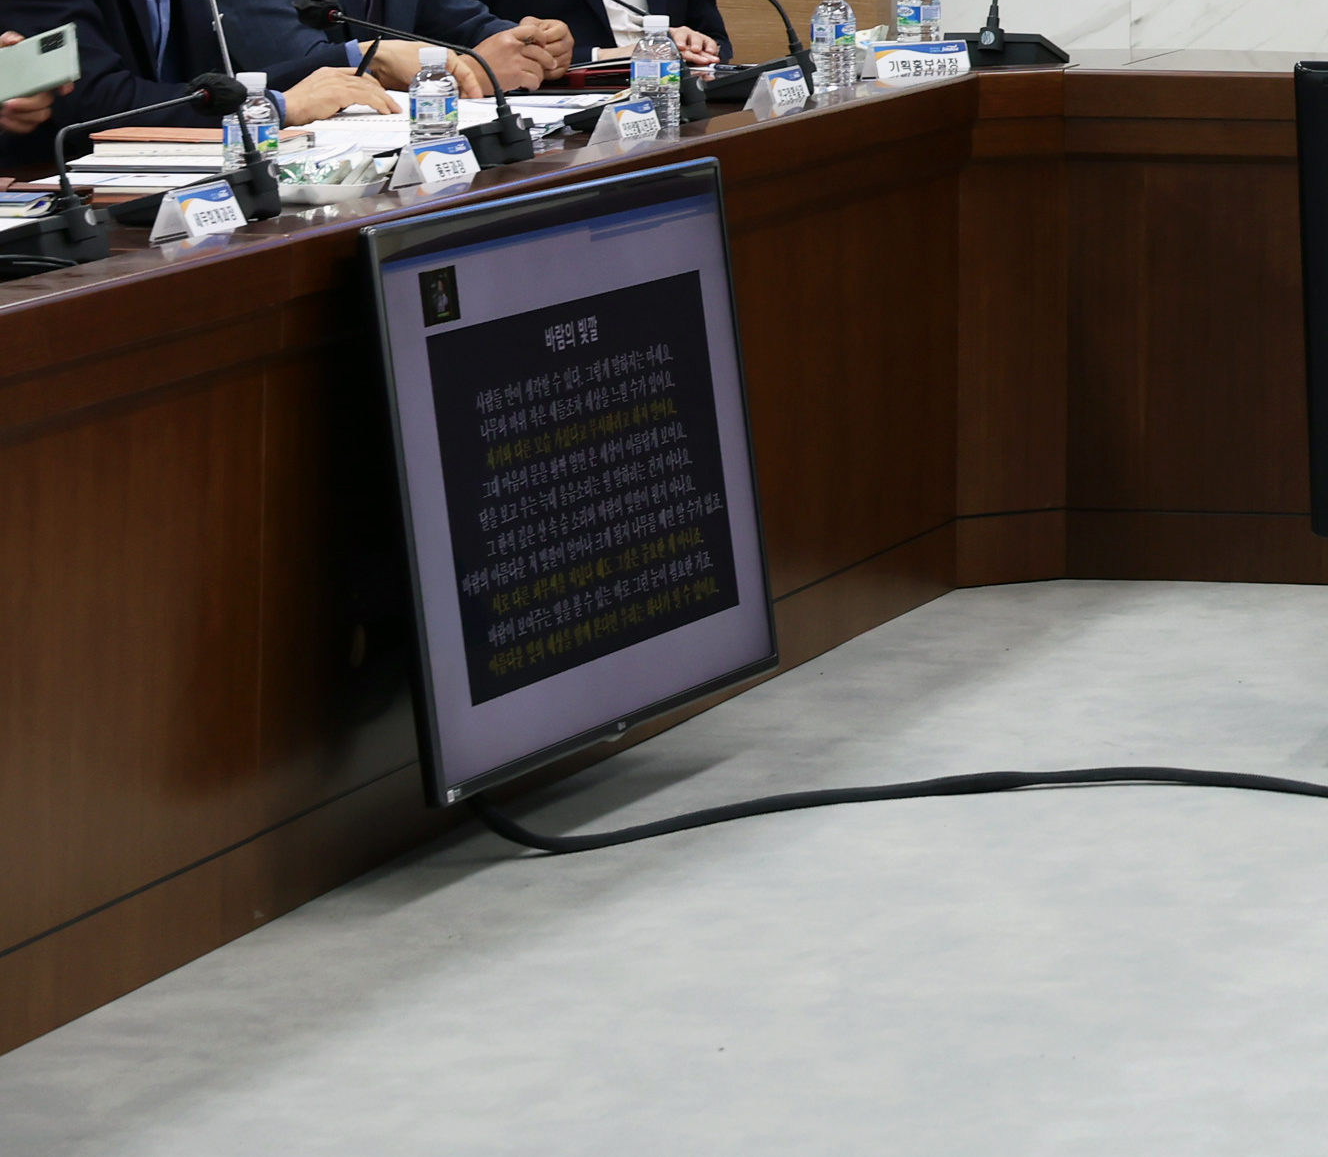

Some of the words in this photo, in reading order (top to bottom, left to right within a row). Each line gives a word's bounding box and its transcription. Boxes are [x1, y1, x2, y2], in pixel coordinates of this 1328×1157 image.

[888, 57, 959, 73] 기획홍보실장
[435, 159, 467, 178] 총무과장
[544, 320, 575, 352] 바람의
[576, 315, 598, 344] 빛깔
